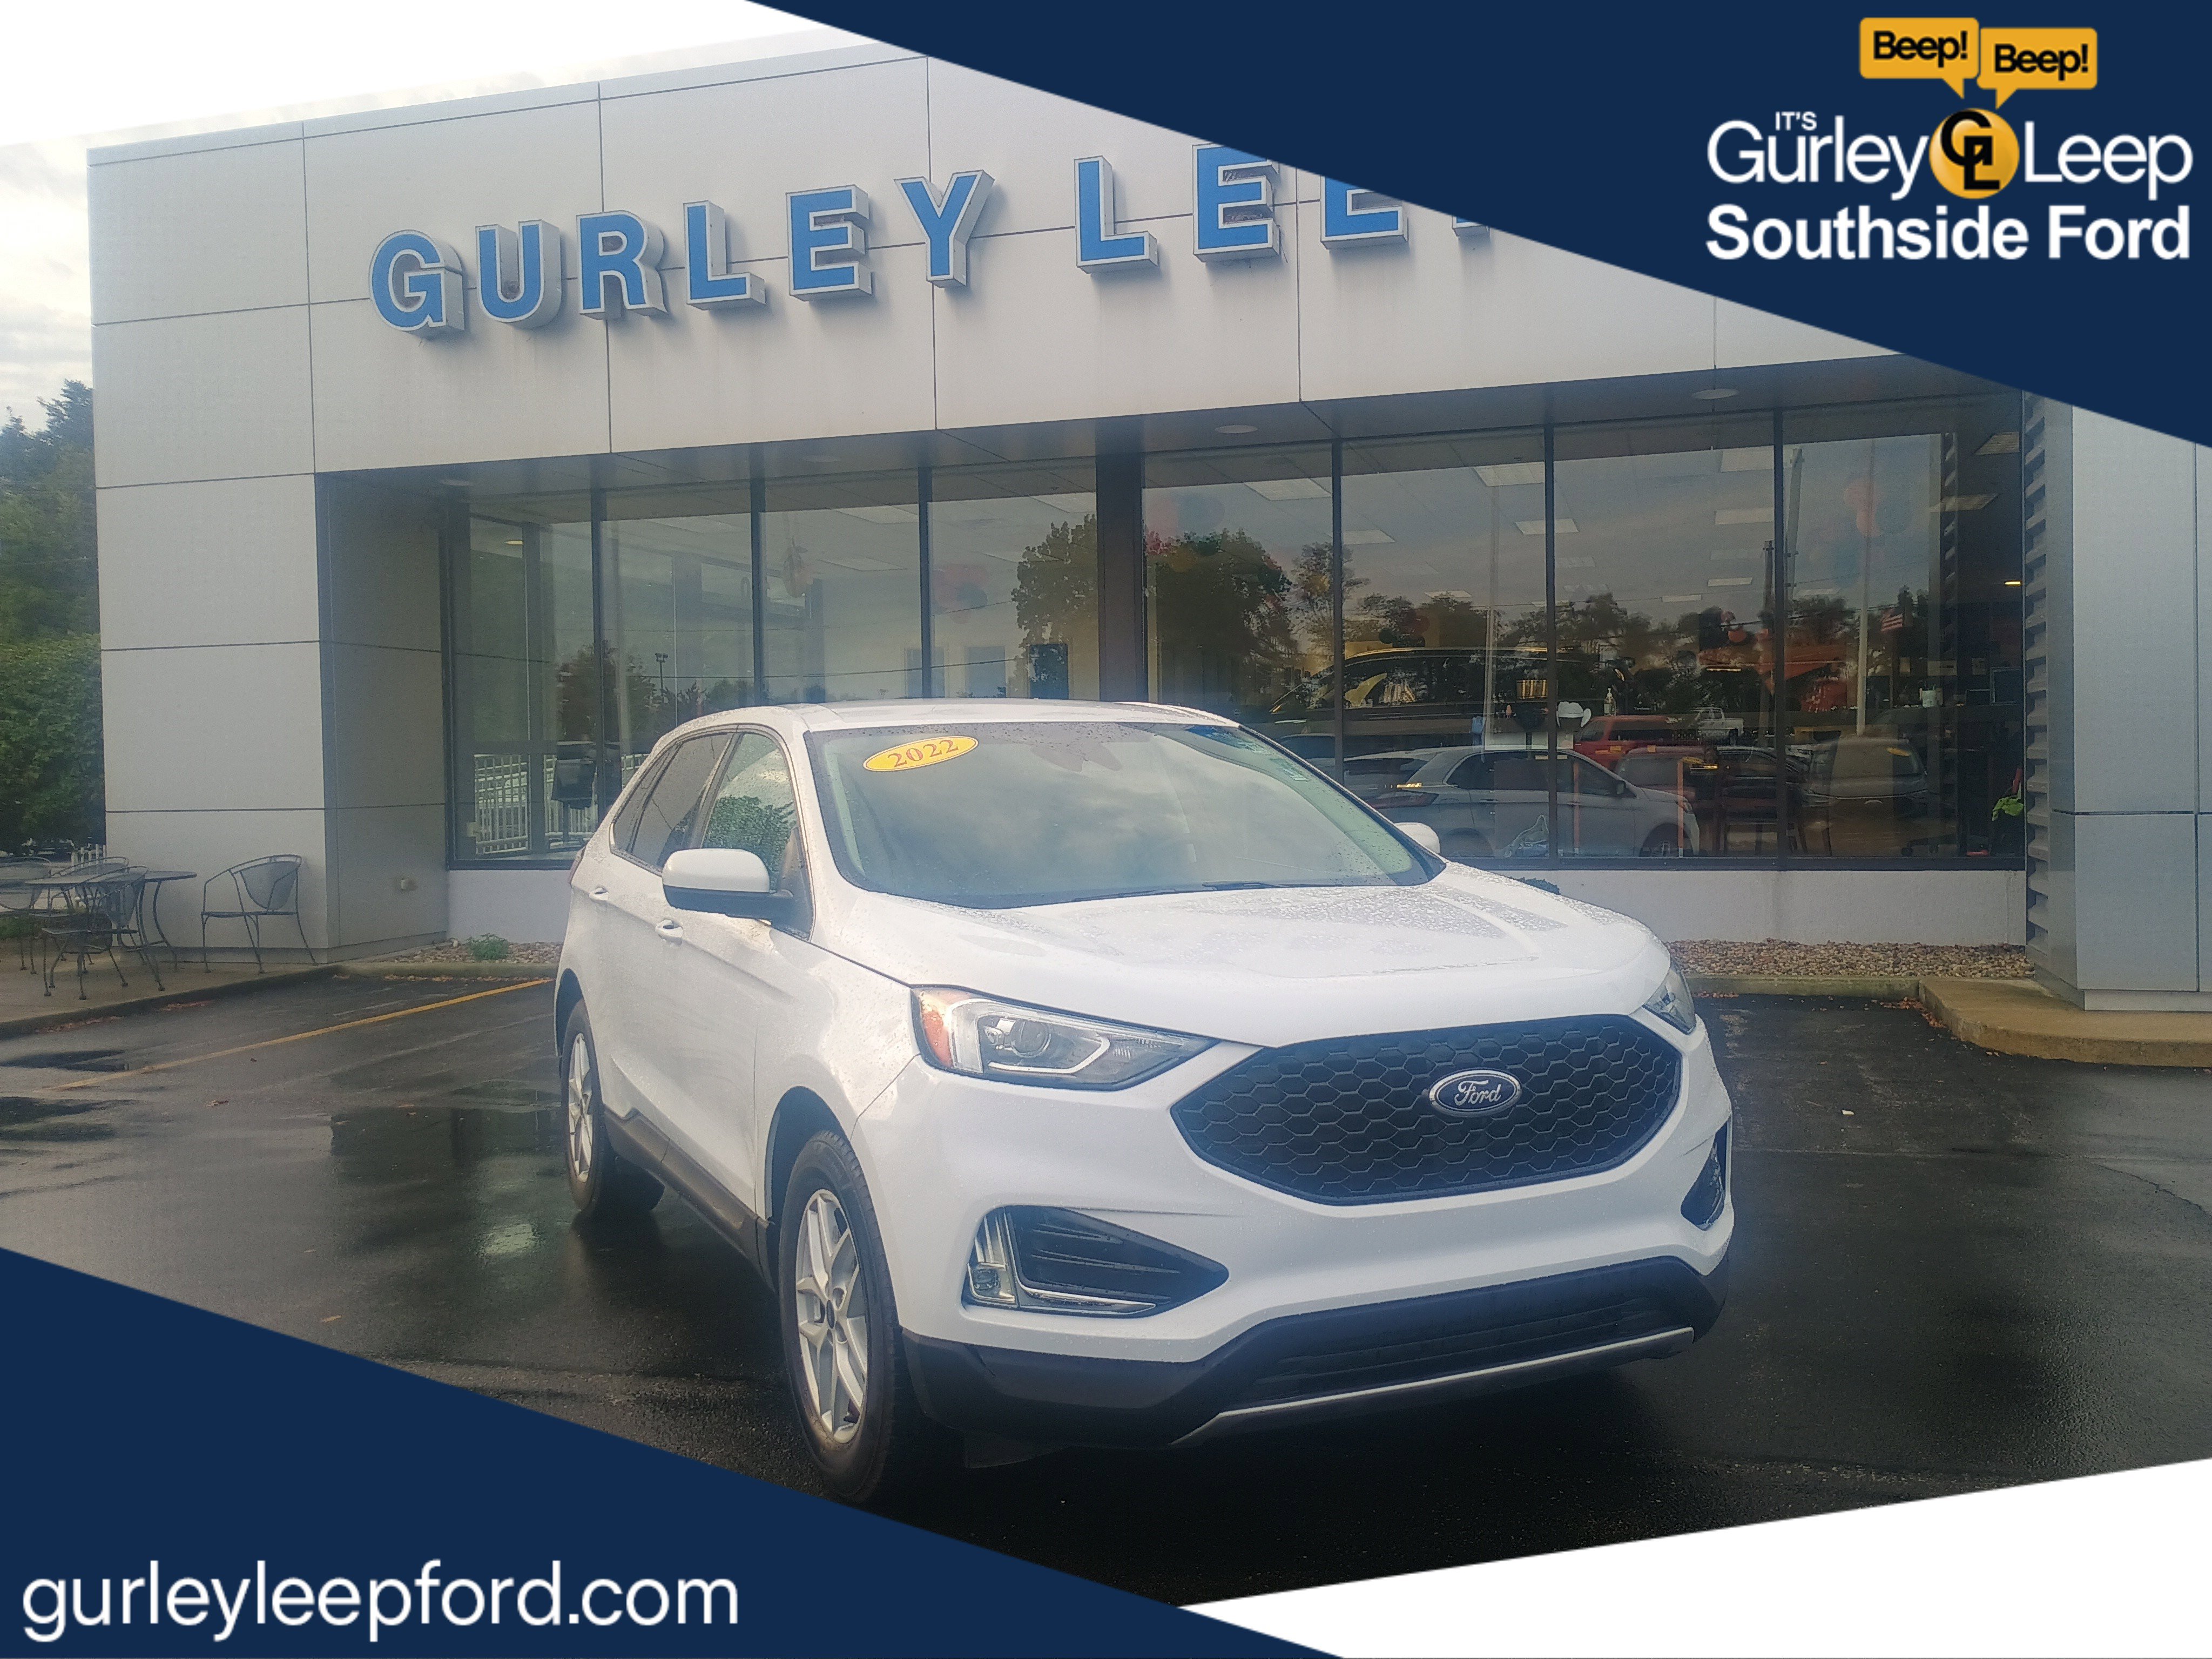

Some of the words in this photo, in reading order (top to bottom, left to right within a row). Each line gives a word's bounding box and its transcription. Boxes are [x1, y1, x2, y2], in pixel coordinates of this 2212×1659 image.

[369, 170, 994, 332] GURLEY
[1074, 144, 1489, 273] LE
[887, 739, 959, 767] 2022
[1454, 1080, 1502, 1106] Ford
